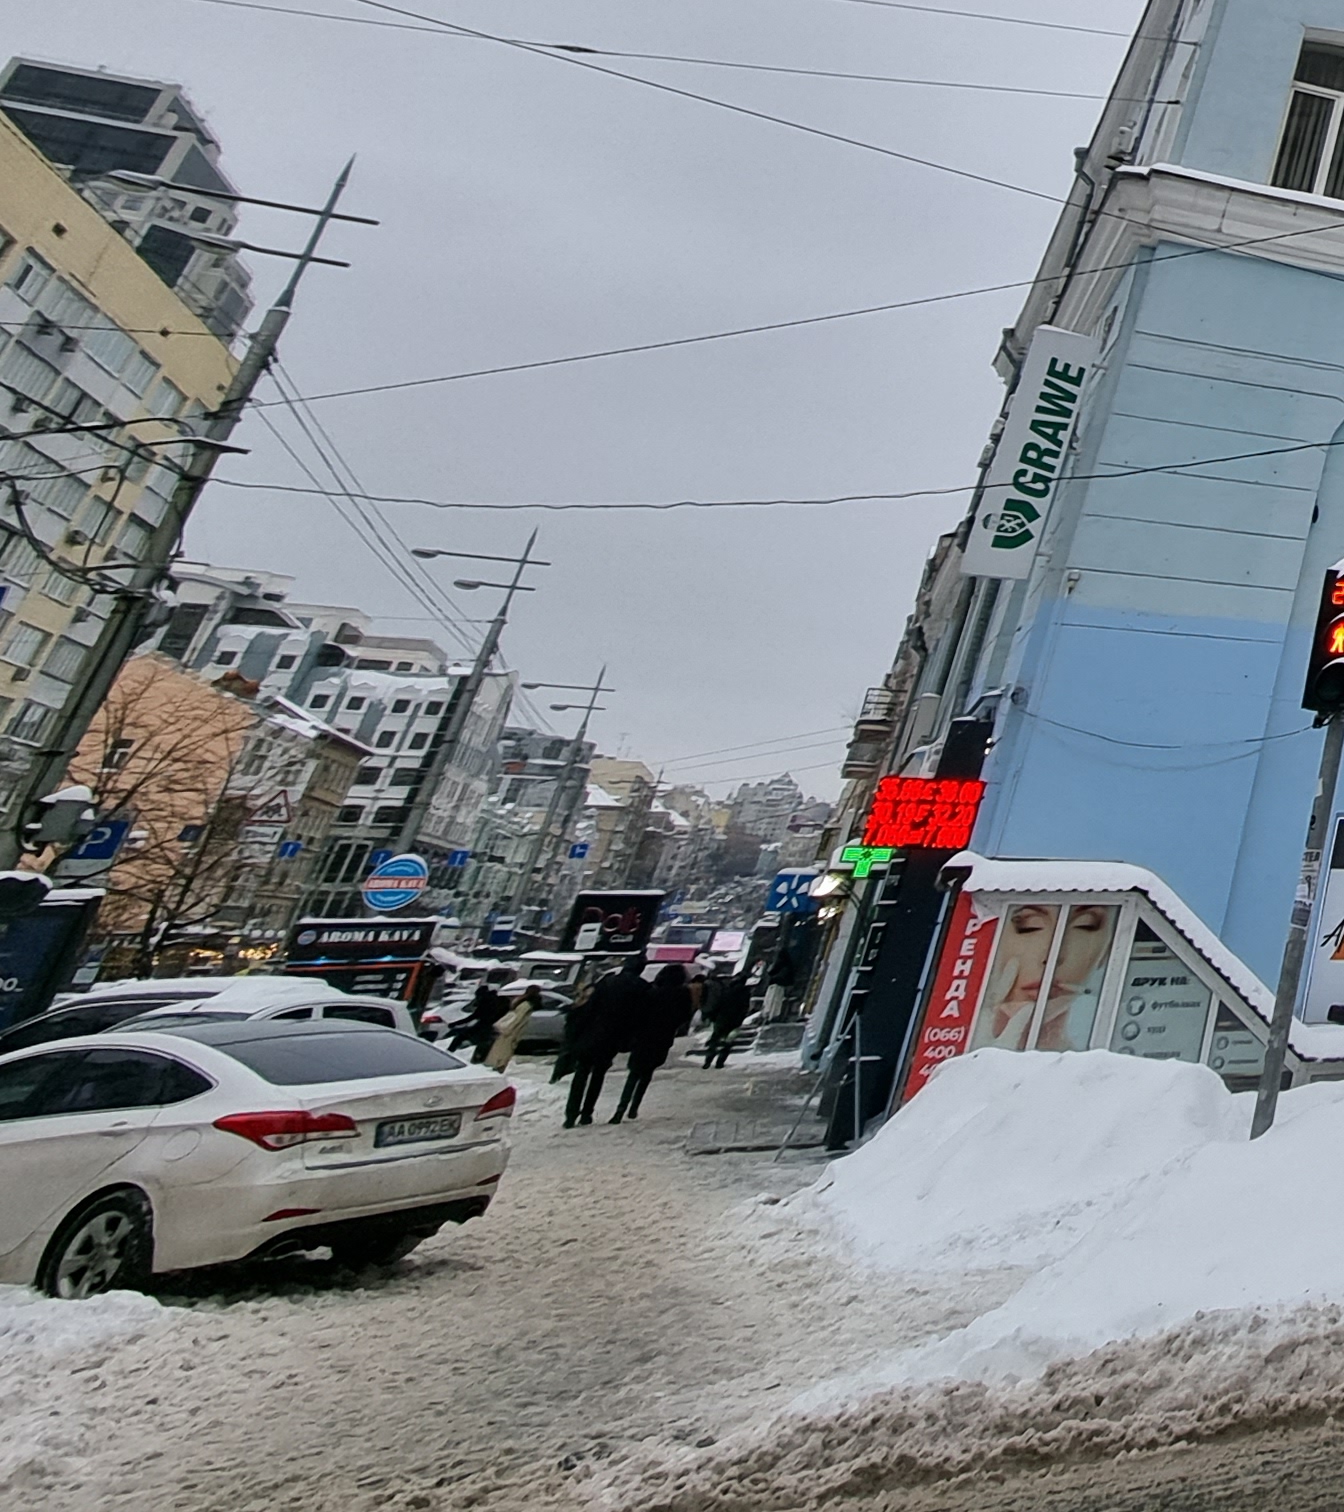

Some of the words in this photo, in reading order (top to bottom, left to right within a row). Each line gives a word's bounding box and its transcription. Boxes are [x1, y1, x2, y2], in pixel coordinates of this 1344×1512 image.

[1012, 356, 1087, 499] GRAWE
[316, 930, 375, 943] AROMA
[377, 929, 421, 942] KAVA
[924, 1026, 966, 1043] (066)
[923, 1045, 956, 1058] 400
